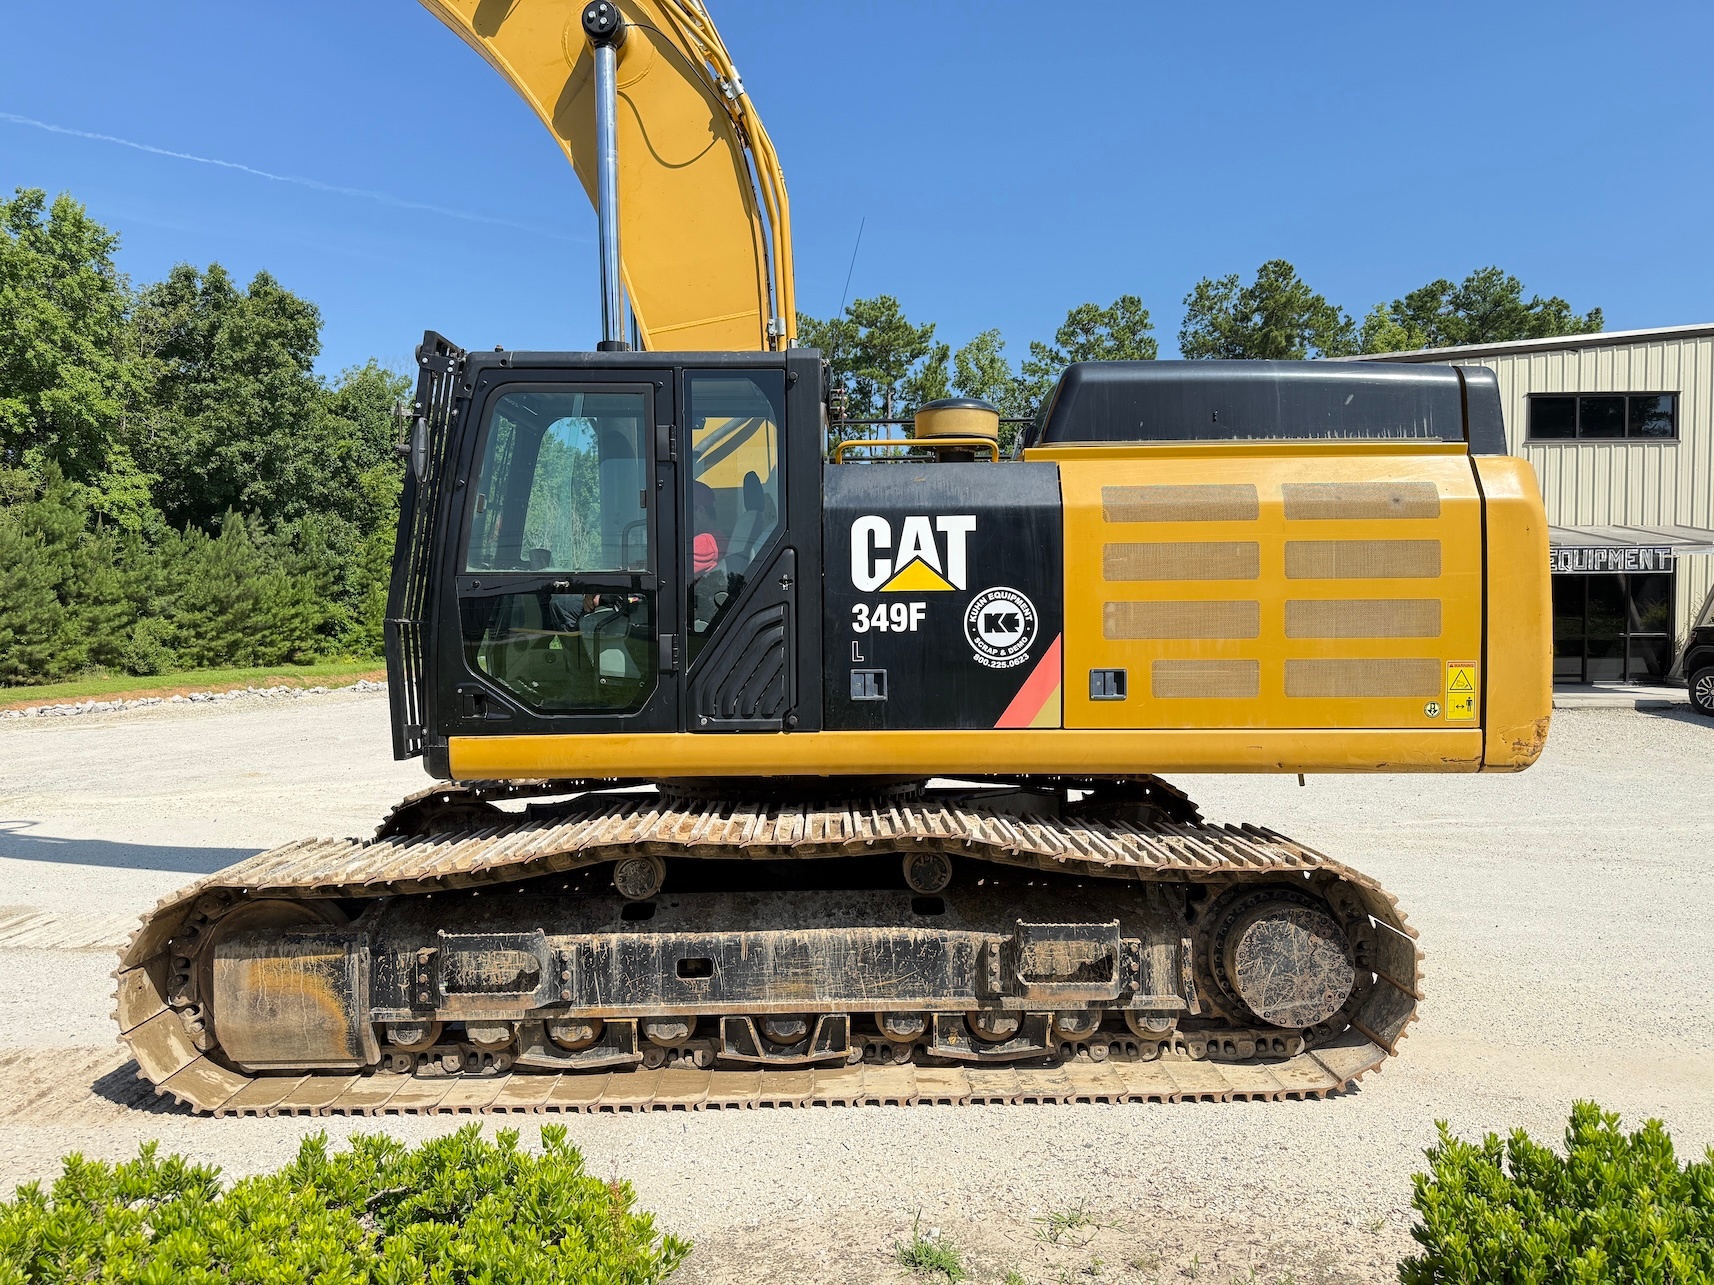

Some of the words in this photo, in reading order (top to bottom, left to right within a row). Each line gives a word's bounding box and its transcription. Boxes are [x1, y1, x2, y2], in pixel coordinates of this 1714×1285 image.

[850, 515, 977, 592] CAT
[852, 602, 926, 633] 349F
[970, 597, 988, 622] KUHN
[988, 592, 1033, 622] EQUIPMENT
[852, 641, 864, 662] L
[974, 637, 998, 655] SCRAP
[1008, 636, 1028, 654] DEMO
[973, 653, 1030, 669] 800.225.0623
